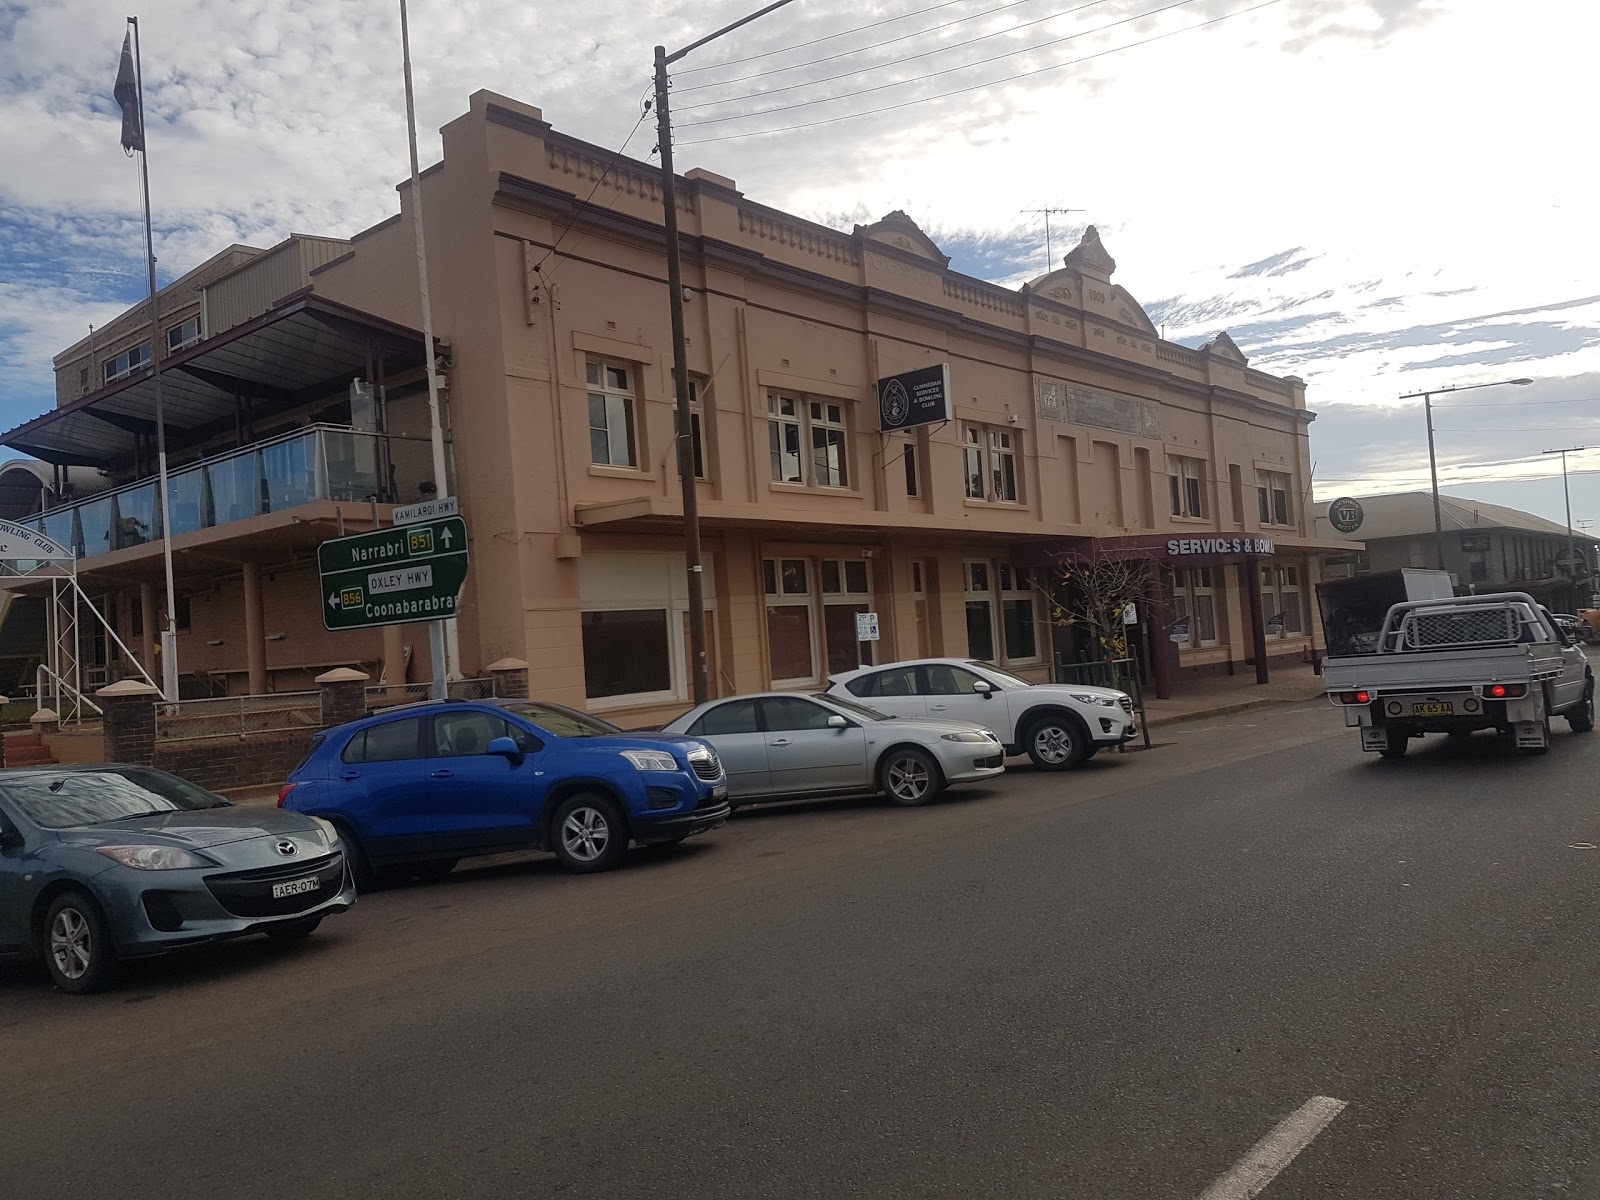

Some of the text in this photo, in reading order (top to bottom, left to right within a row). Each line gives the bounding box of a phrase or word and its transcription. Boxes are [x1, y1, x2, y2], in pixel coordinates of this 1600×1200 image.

[912, 380, 942, 390] GUNNEDAH
[916, 387, 939, 396] SERVICES
[919, 393, 942, 403] BOWLING
[1333, 500, 1358, 509] VICTORIA
[394, 501, 455, 522] KAMILAROI HWY
[1338, 509, 1357, 521] VB
[34, 538, 54, 554] CLUB
[352, 534, 430, 562] Narrabri B51
[1244, 538, 1253, 552] &
[371, 570, 428, 589] OXLEY HWY
[343, 592, 361, 604] B56
[870, 614, 875, 622] P
[1415, 703, 1450, 713] AK 65 AA
[280, 878, 319, 896] AER-07M
